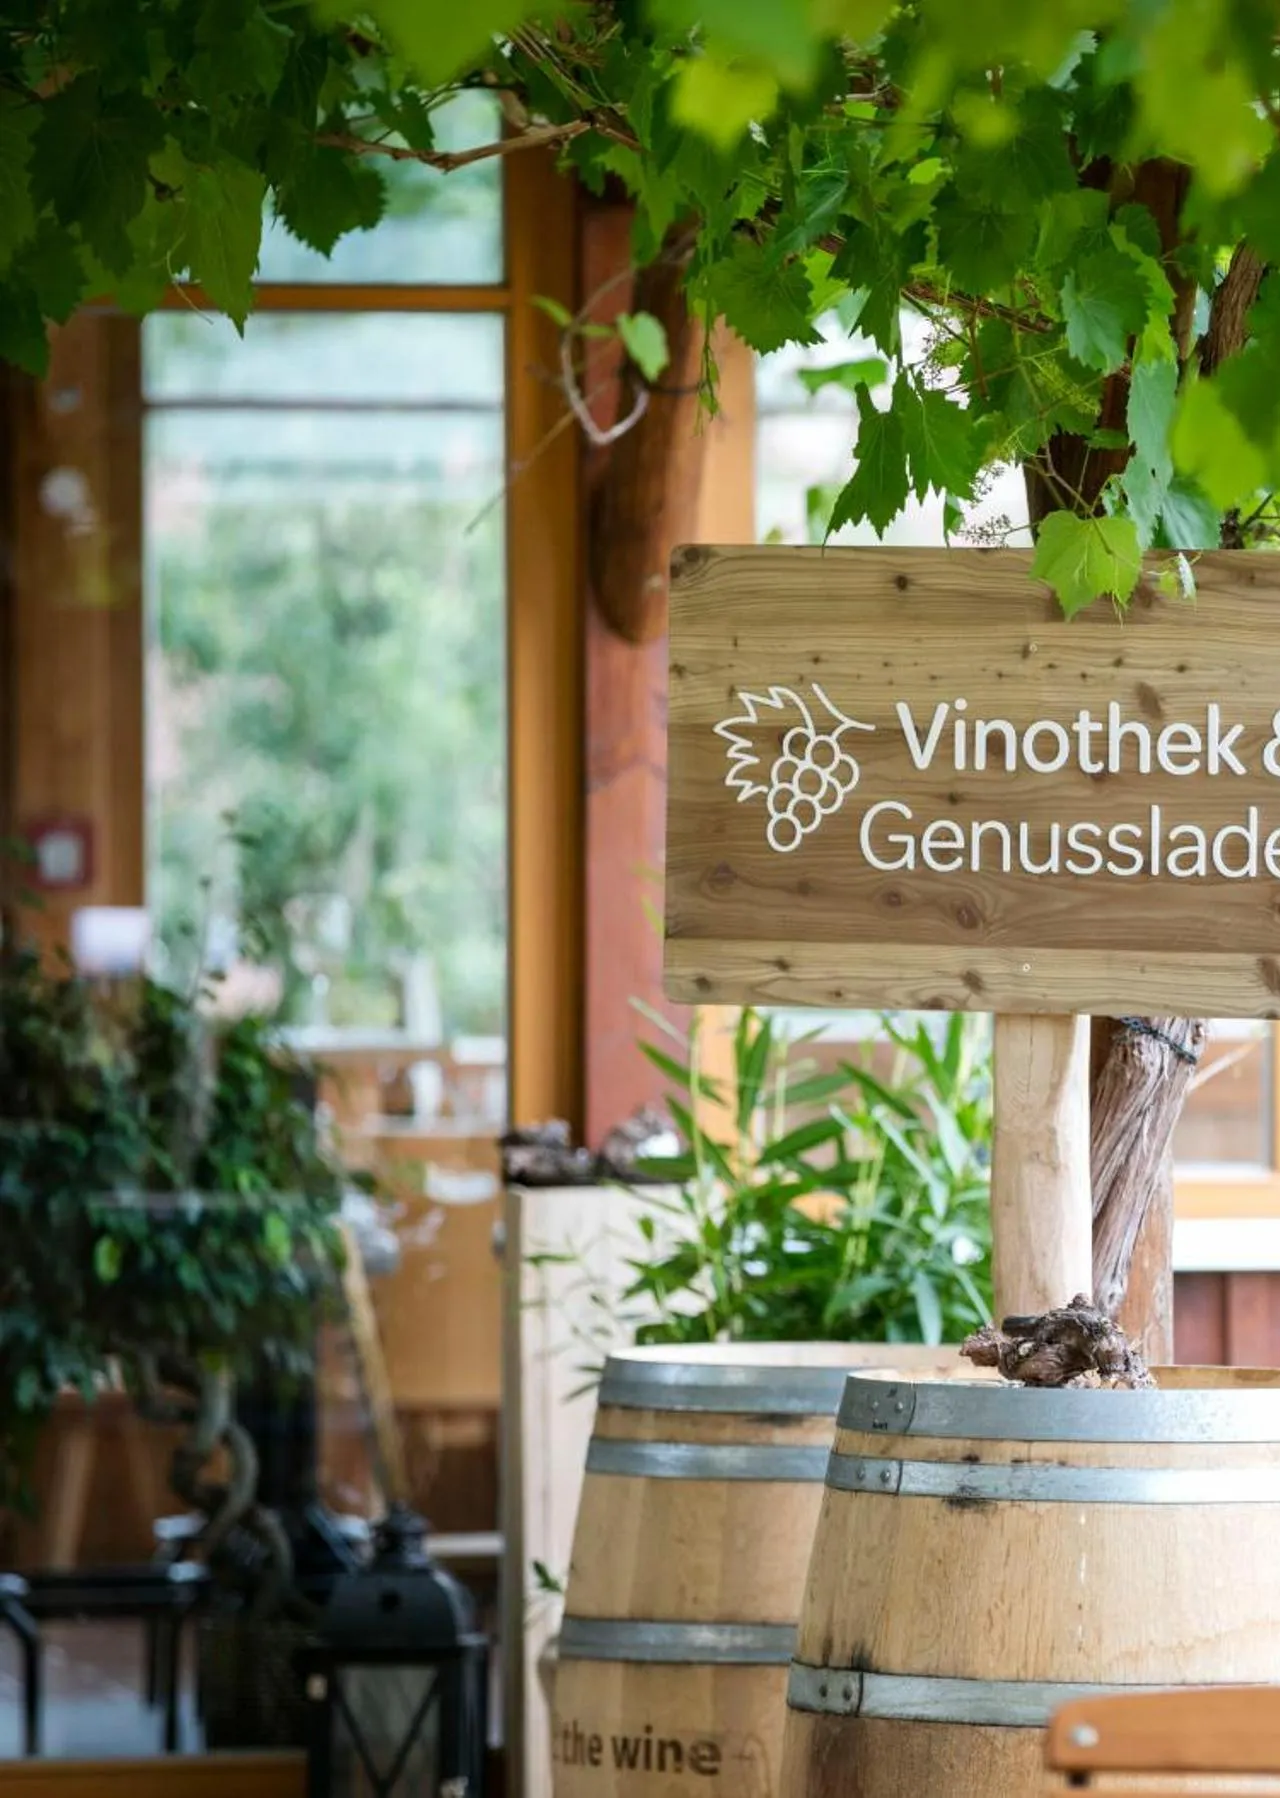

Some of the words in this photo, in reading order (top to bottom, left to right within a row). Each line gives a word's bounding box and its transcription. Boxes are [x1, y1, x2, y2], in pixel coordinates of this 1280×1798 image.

[895, 697, 1248, 776] Vinothek
[561, 1719, 604, 1768] the
[610, 1724, 723, 1777] wine
